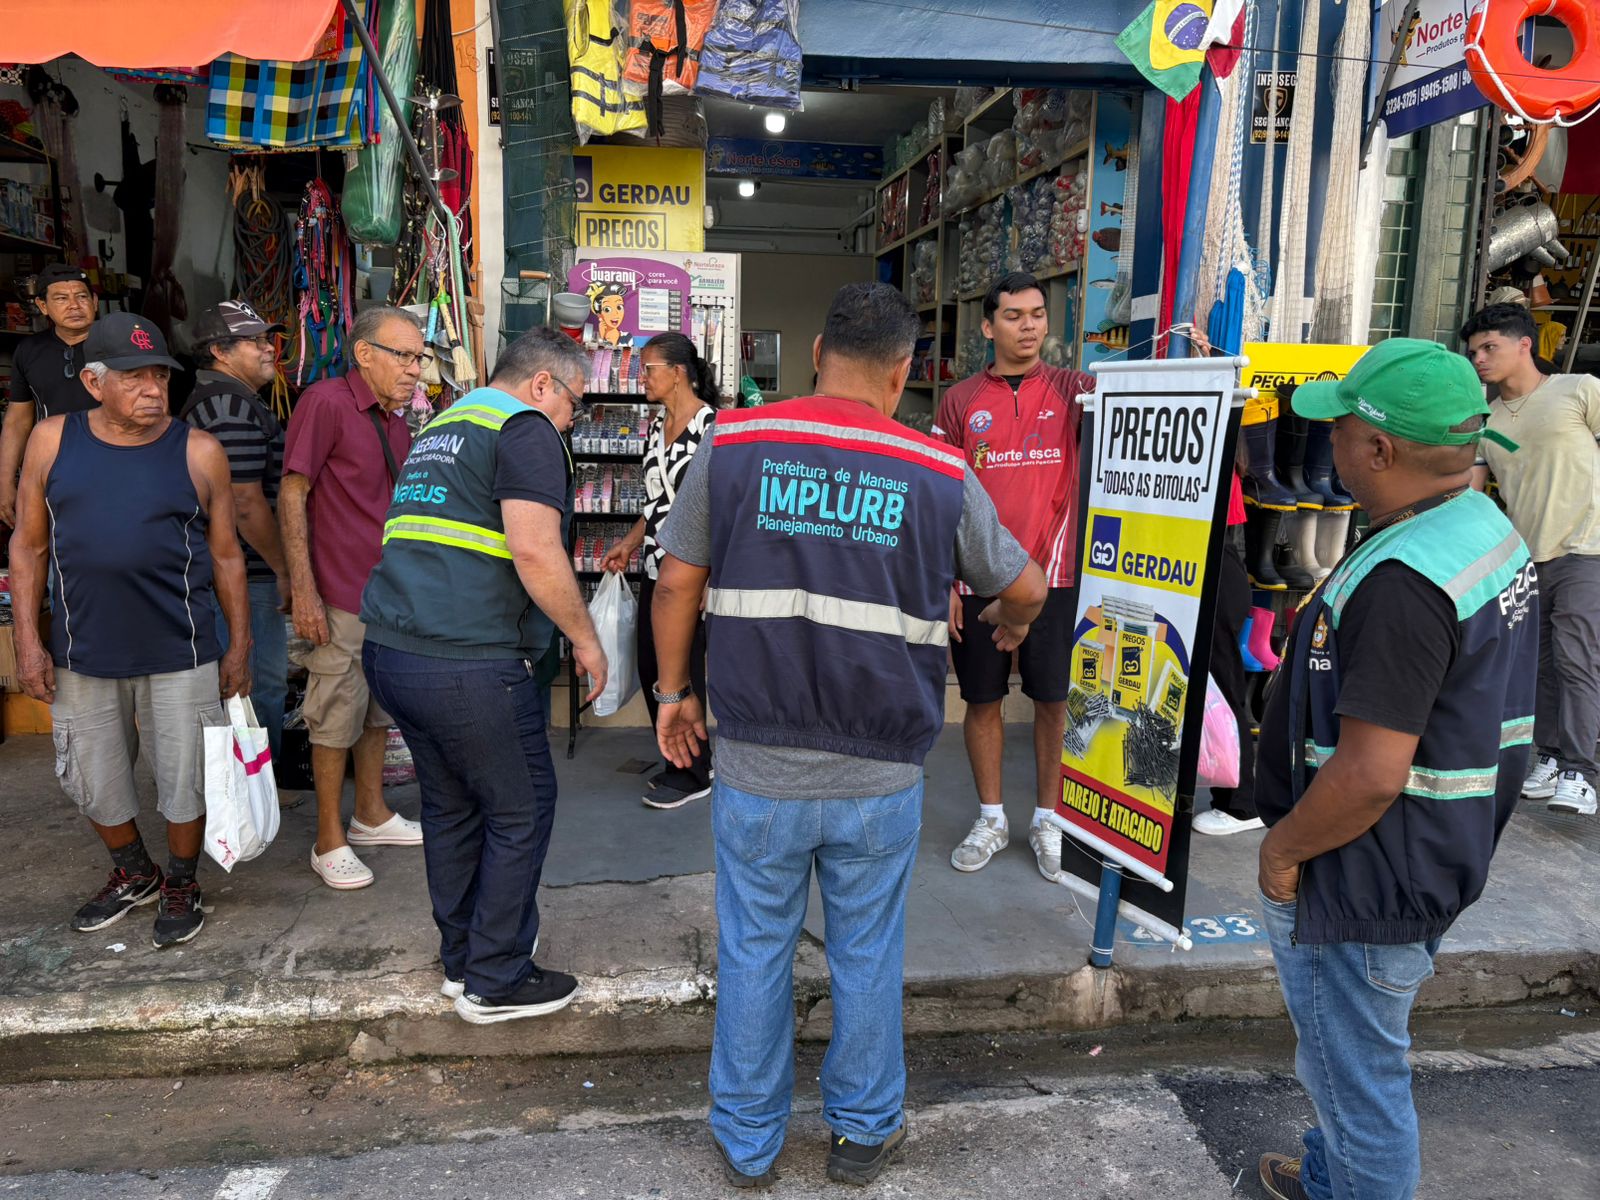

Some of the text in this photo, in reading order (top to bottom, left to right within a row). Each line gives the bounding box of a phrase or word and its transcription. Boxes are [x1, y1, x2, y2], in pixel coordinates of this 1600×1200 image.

[1417, 11, 1464, 47] Norte
[1426, 35, 1458, 55] Produtos
[1257, 73, 1297, 87] INFSEG
[599, 183, 690, 206] GERDAU
[586, 218, 659, 248] PREGOS
[590, 262, 636, 291] Guarany
[1249, 374, 1295, 389] PEGA
[1108, 406, 1207, 465] PREGOS
[986, 448, 1023, 464] Norte
[762, 459, 908, 494] Prefeitura de Manaus
[1103, 469, 1201, 503] TODAS AS BITOLAS
[759, 475, 906, 531] IMPLURB
[756, 513, 899, 548] Planejamento Urbano
[1121, 551, 1198, 587] GERDAU
[1082, 647, 1100, 659] PREGOS
[1122, 632, 1146, 646] PREGOS
[1079, 679, 1097, 690] GERDAU
[1118, 676, 1142, 690] GERDAU
[1062, 776, 1163, 852] VAREJO E ATACADO
